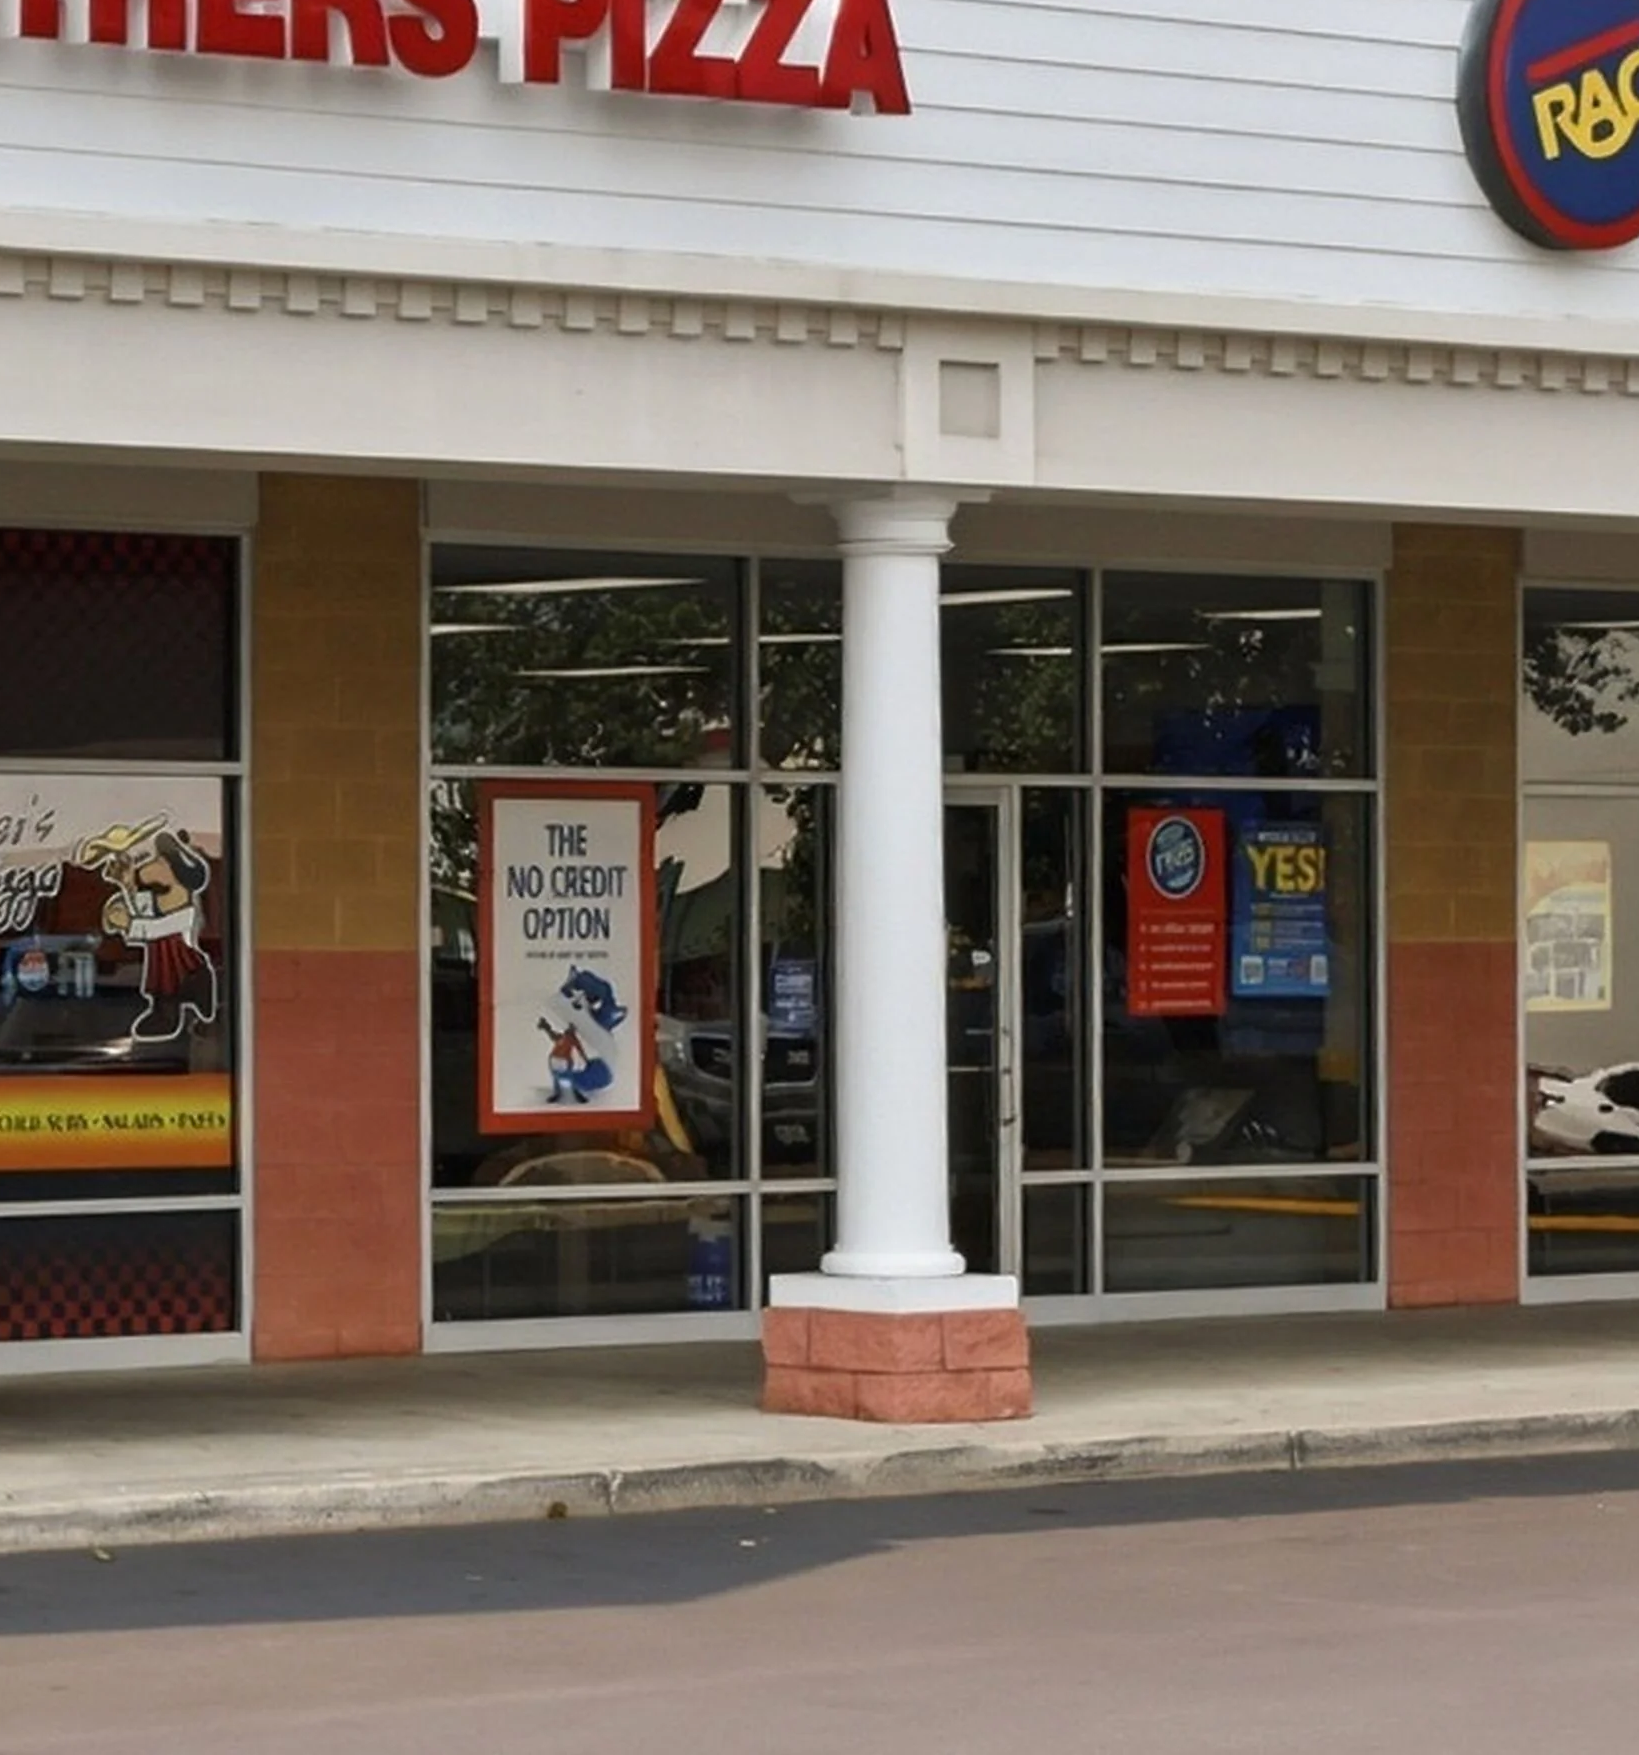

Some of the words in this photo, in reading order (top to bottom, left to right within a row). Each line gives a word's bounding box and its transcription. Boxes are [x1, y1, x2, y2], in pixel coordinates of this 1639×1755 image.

[545, 824, 588, 858] THE
[507, 865, 544, 899] NO
[550, 865, 628, 899] CREDIT
[523, 907, 611, 941] OPTION
